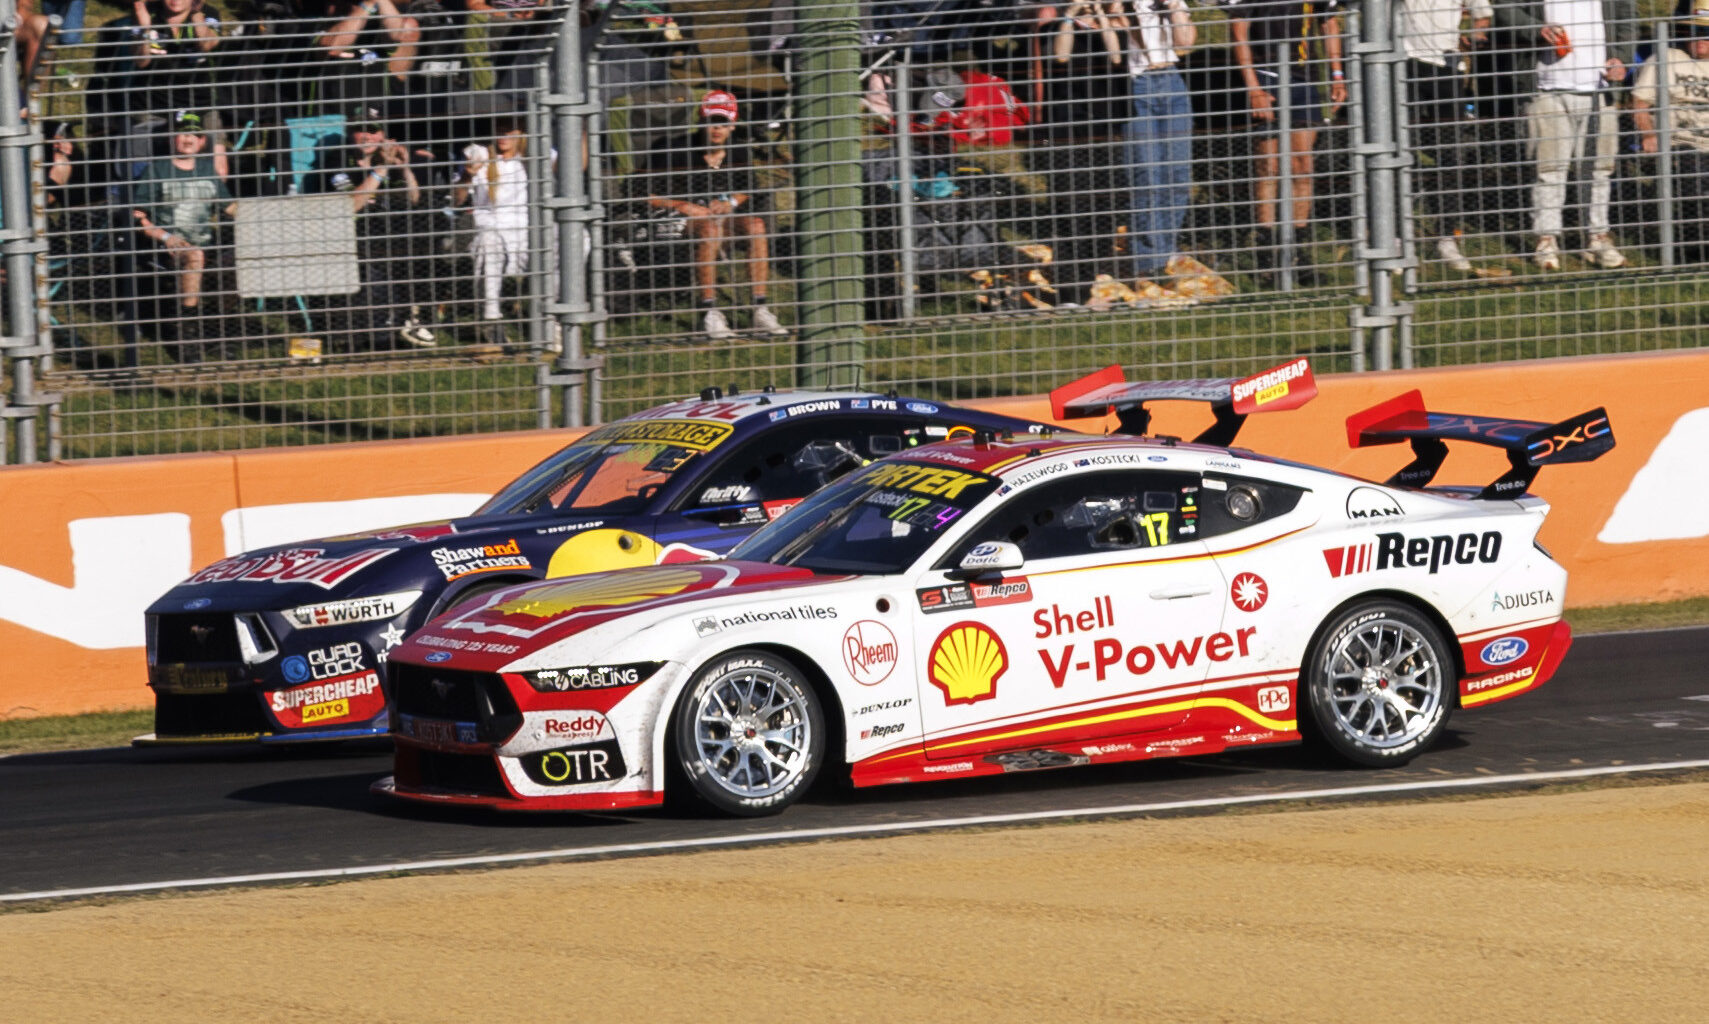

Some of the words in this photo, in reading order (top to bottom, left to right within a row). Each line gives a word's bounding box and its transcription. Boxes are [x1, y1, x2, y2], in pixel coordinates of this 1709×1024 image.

[1233, 359, 1308, 402] SUPERCHEAP
[1259, 387, 1286, 401] AUTO
[787, 399, 841, 417] BROWN
[871, 399, 898, 410] PYE
[1010, 462, 1069, 488] HAZELWOOD
[1090, 454, 1141, 466] KOSTECKI
[888, 497, 932, 520] 17
[1351, 507, 1401, 519] MAN
[548, 521, 604, 533] DUNLOP
[1140, 512, 1169, 547] 17
[1375, 531, 1503, 575] Repco
[438, 556, 531, 579] Partners
[990, 583, 1027, 597] Repco
[1491, 589, 1554, 612] ADJUSTA
[722, 607, 798, 629] national
[799, 605, 838, 620] tiles
[1033, 595, 1115, 639] Shell
[308, 642, 362, 665] QUAD
[846, 622, 896, 676] Rheem
[1037, 625, 1257, 689] V-Power
[1488, 640, 1520, 662] Ford
[311, 655, 367, 680] LOCK
[570, 668, 639, 689] CABLING
[1467, 667, 1533, 691] RACING
[272, 673, 380, 712] SUPERCHEAP
[1260, 690, 1288, 709] PPG
[304, 703, 344, 718] AUTO
[859, 698, 913, 716] DUNLOP
[545, 716, 607, 736] Reddy
[870, 723, 905, 738] Repco
[542, 750, 611, 781] OTR
